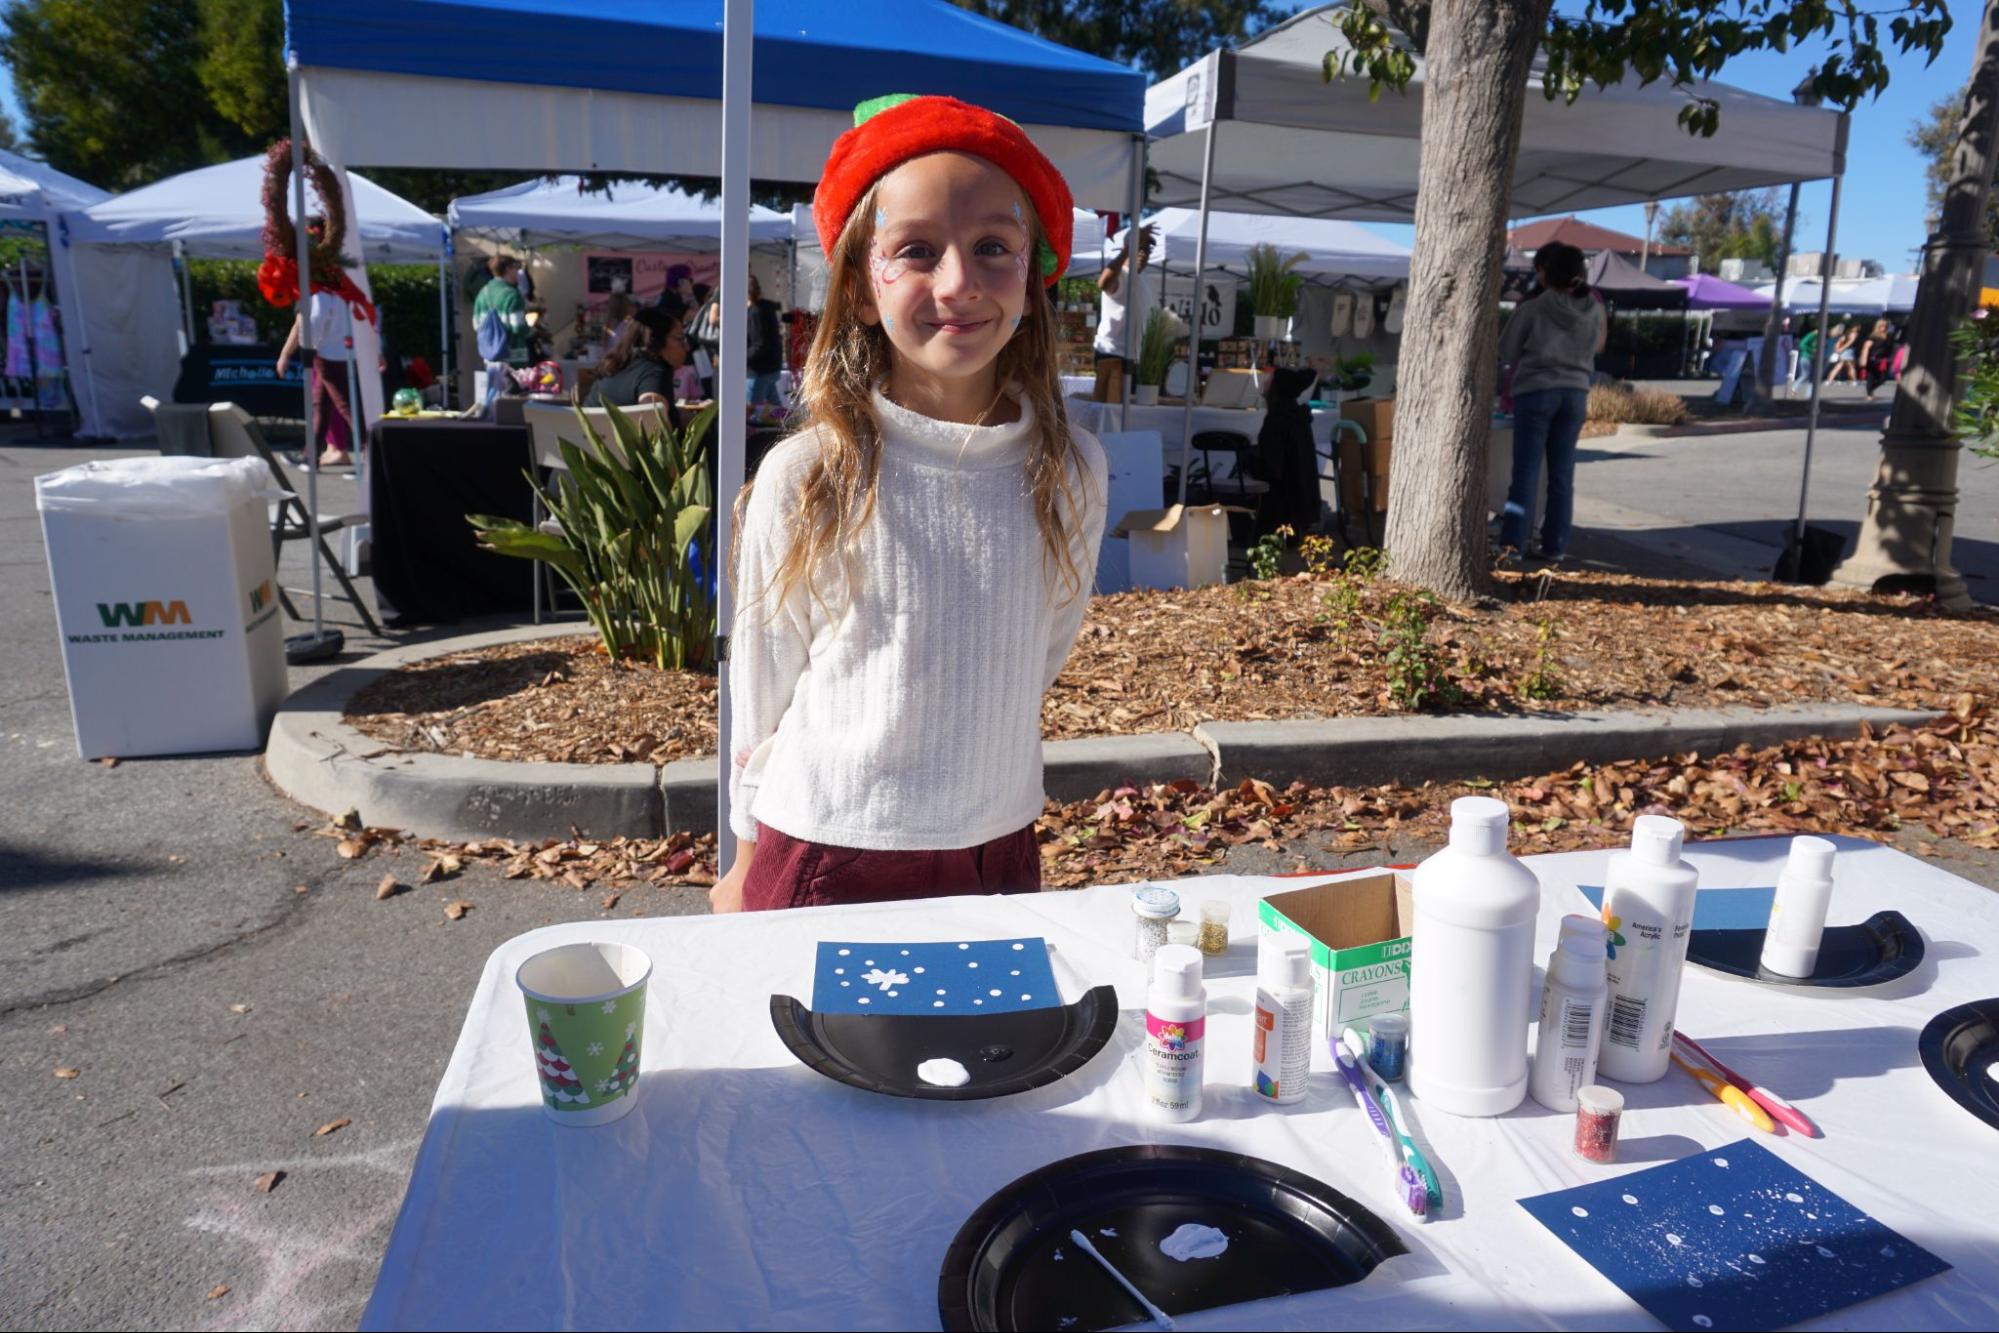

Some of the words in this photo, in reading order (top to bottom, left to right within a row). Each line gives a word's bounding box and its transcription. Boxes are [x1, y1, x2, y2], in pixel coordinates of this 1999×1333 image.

[96, 600, 191, 627] WM
[68, 634, 118, 643] WASTE
[121, 630, 224, 641] MANAGEMENT
[1341, 960, 1401, 985] CRAYONS
